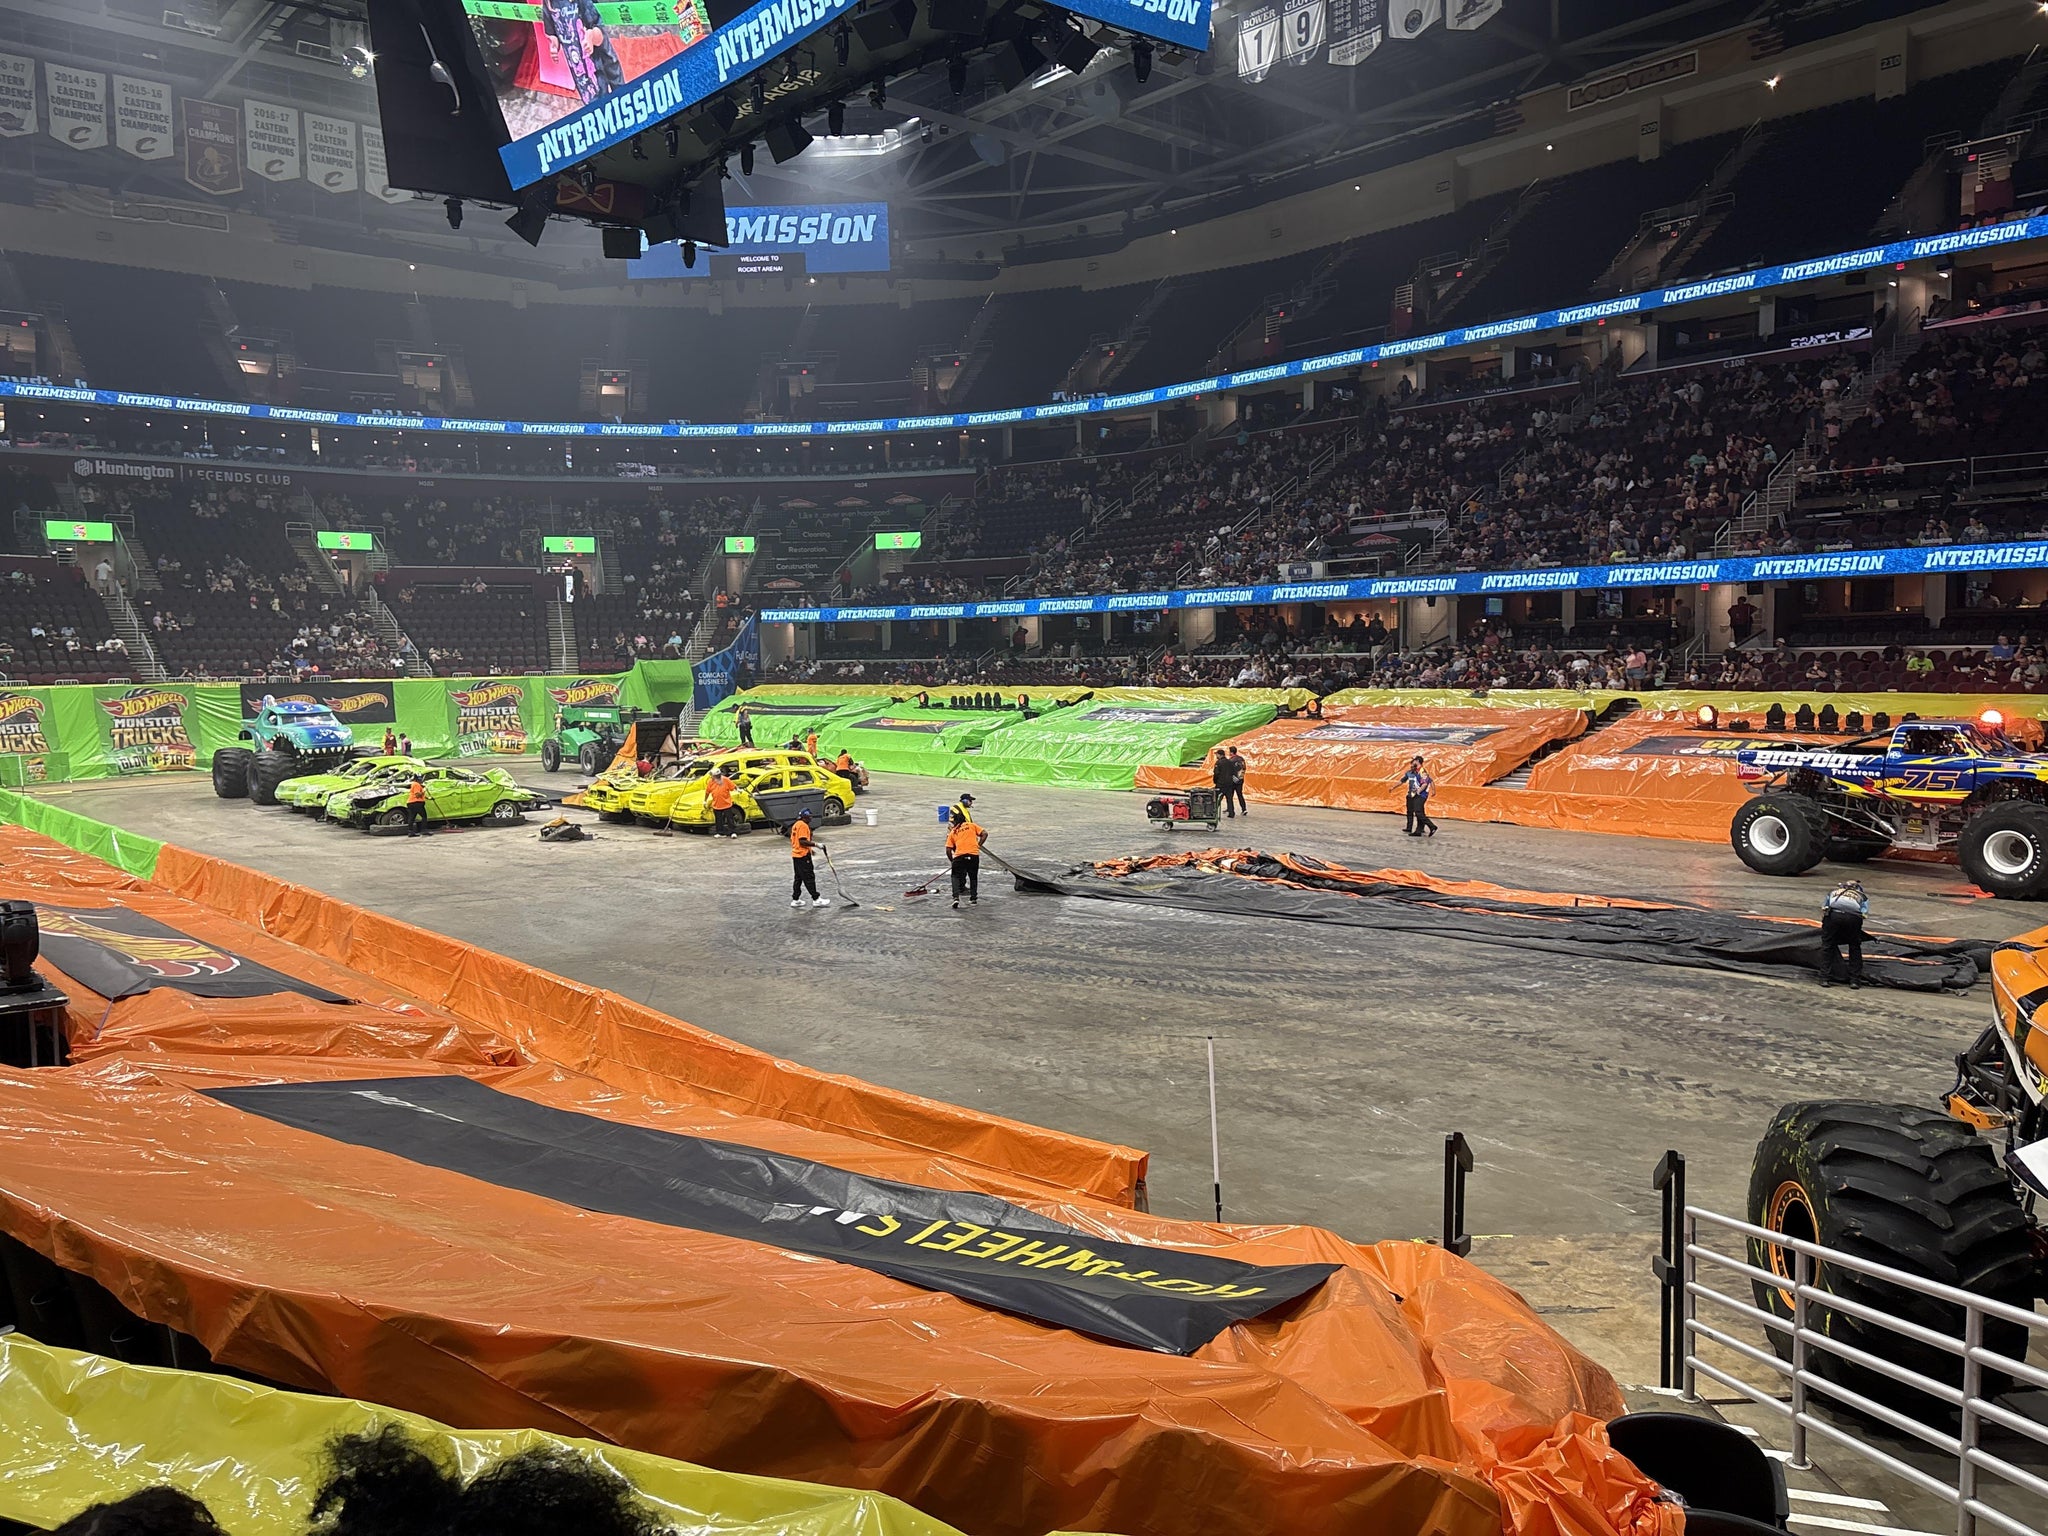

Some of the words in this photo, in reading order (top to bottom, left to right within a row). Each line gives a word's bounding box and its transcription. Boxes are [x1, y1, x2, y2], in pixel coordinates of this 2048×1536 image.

[1243, 9, 1276, 29] BOWER
[1297, 11, 1310, 47] 9
[1254, 30, 1263, 65] 1
[54, 71, 97, 88] 2014-15
[0, 86, 33, 99] ERENCE
[56, 84, 96, 100] EASTERN
[122, 83, 163, 98] 2015-16
[50, 95, 104, 113] CONFERENCE
[125, 96, 162, 111] EASTERN
[53, 107, 103, 124] CHAMPIONS
[118, 106, 170, 124] CONFERENCE
[254, 108, 290, 122] 2016-17
[536, 68, 683, 174] INTERMISSION
[120, 118, 169, 134] CHAMPIONS
[202, 120, 220, 130] NBA
[256, 120, 289, 135] EASTERN
[312, 120, 348, 136] 2017-18
[188, 128, 235, 145] CHAMPIONS
[249, 130, 296, 147] CONFERENCE
[314, 133, 347, 147] EASTERN
[252, 141, 295, 157] CHAMPIONS
[309, 142, 354, 160] CONFERENCE
[1952, 147, 1969, 156] 210
[311, 154, 353, 169] CHAMPIONS
[1913, 223, 2029, 255] INTERMISSION
[1782, 250, 1884, 280] INTERMISSION
[1664, 275, 1756, 303] INTERMISSION
[1558, 297, 1640, 323] INTERMISSION
[1464, 318, 1538, 341] INTERMISSION
[1380, 335, 1445, 356] INTERMISSION
[1302, 350, 1362, 371] INTERMISSION
[1232, 366, 1287, 384] INTERMISSION
[14, 384, 97, 400] INTERMISSION
[1167, 380, 1217, 396] INTERMISSION
[117, 394, 172, 408] INTERMIS
[175, 399, 250, 414] INTERMISSION
[1104, 391, 1154, 407] INTERMISSION
[270, 408, 338, 422] INTERMISSION
[1036, 401, 1089, 416] INTERMISSION
[357, 415, 425, 427] INTERMISSION
[898, 417, 953, 428] INTERMISSION
[969, 411, 1022, 423] INTERMISSION
[442, 419, 505, 432] INTERMISSION
[523, 423, 584, 434] INTERMISSION
[602, 424, 662, 436] INTERMISSION
[678, 425, 737, 436] INTERMISSION
[754, 423, 811, 434] INTERMISSION
[828, 420, 883, 432] INTERMISSION
[95, 460, 174, 480] Huntington
[189, 470, 251, 483] LEGENDS
[256, 473, 291, 485] CLUB
[788, 545, 829, 553] Restoration.
[1924, 546, 2048, 568] INTERMISSI
[1608, 565, 1720, 584] INTERMISSION
[1753, 556, 1886, 577] INTERMISSION
[1371, 579, 1458, 595] INTERMISSION
[1482, 572, 1579, 590] INTERMISSION
[1185, 589, 1252, 604] INTERMISSION
[1272, 585, 1348, 601] INTERMISSION
[976, 604, 1025, 615] INTERMISSION
[1039, 600, 1093, 611] INTERMISSION
[1108, 595, 1168, 608] INTERMISSION
[761, 610, 820, 621] NTERMISSION
[838, 609, 895, 620] INTERMISSION
[911, 606, 963, 617] INTERMISSION
[460, 705, 518, 716] MONSTER
[114, 716, 181, 729] MONSTER
[457, 714, 522, 735] TRUCKS
[0, 733, 49, 752] UCKS
[111, 726, 191, 750] TRUCKS
[462, 739, 491, 756] GLOW
[499, 738, 522, 750] FIRE
[120, 755, 149, 770] GLOW
[163, 753, 190, 766] FIRE
[1752, 751, 1859, 769] BIGFOOT
[1831, 768, 1881, 777] Firestone
[1904, 769, 1961, 791] 75
